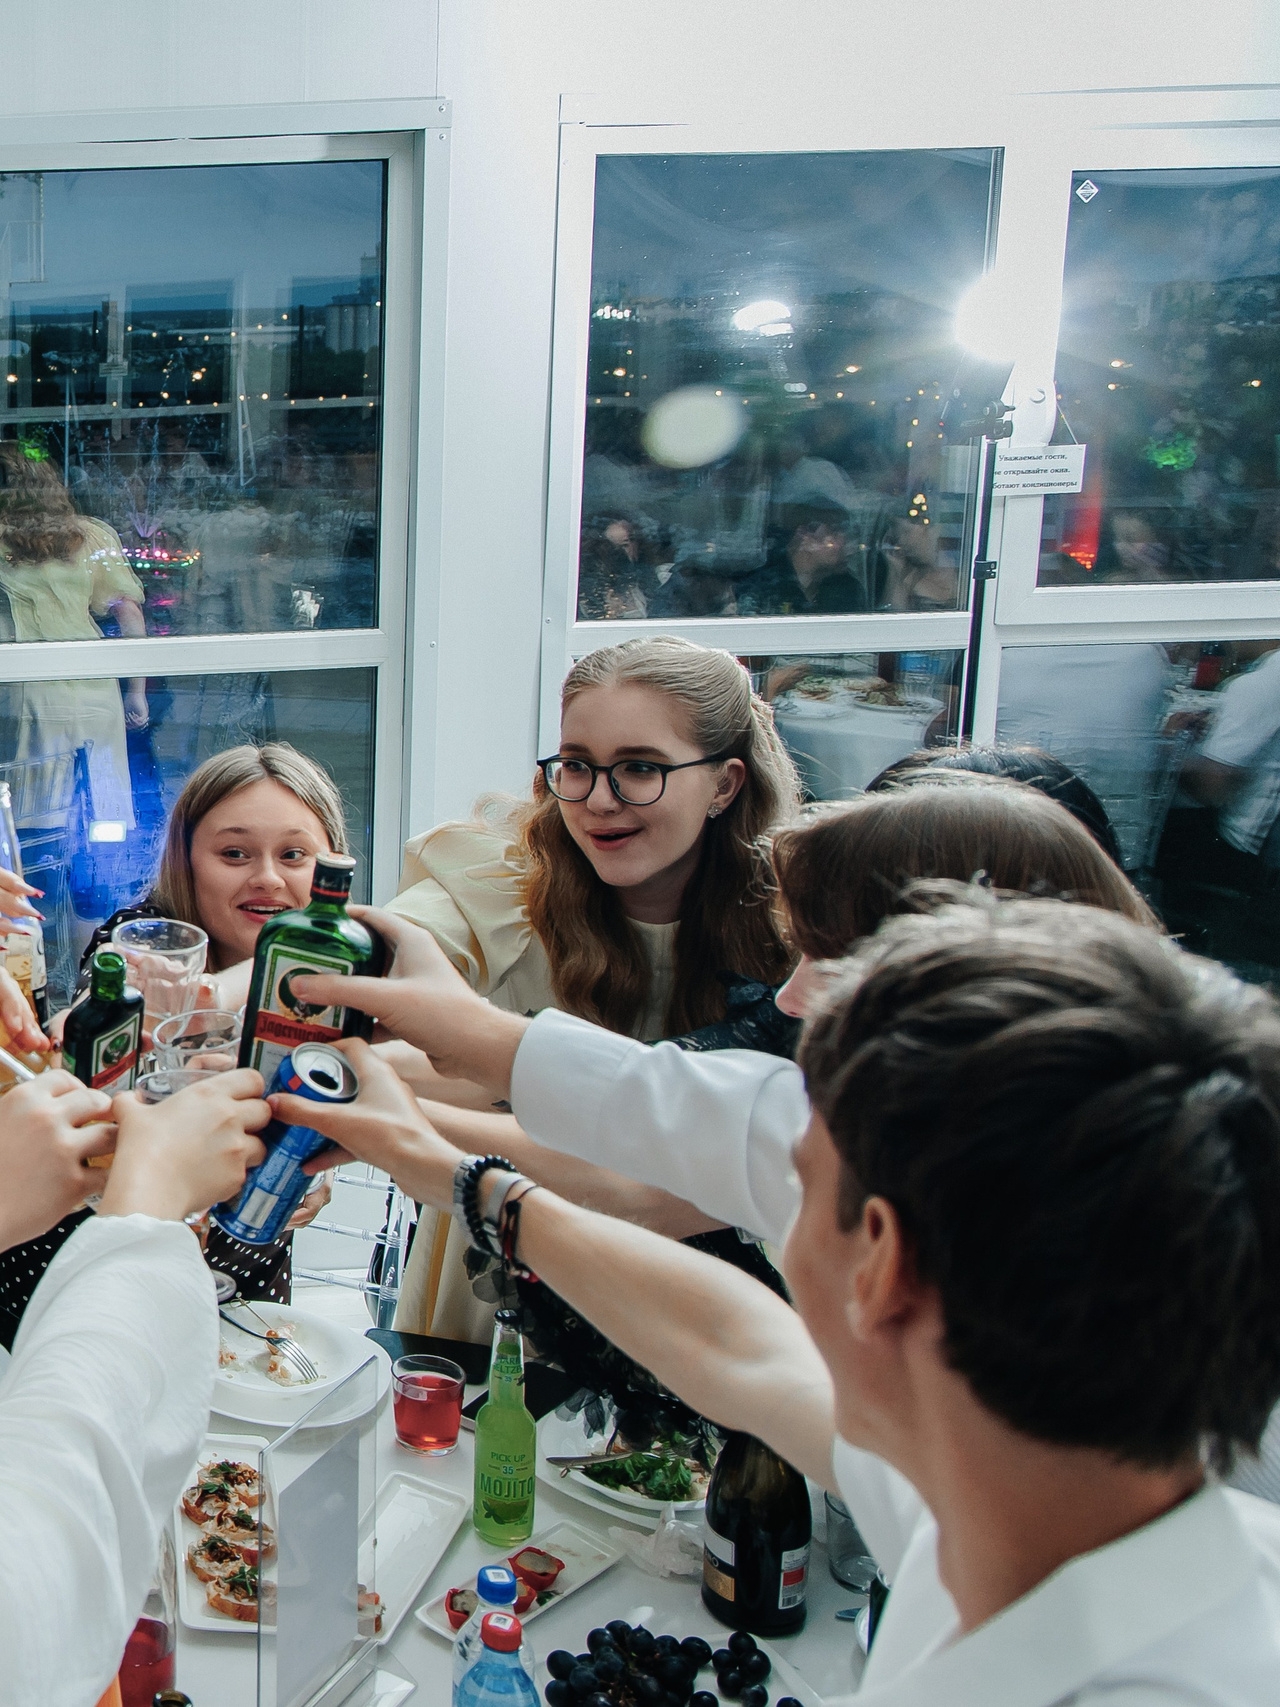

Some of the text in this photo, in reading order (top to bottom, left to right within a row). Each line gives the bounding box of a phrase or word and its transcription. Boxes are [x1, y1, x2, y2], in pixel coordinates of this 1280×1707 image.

[1022, 481, 1078, 490] кондиционеры
[491, 1451, 526, 1463] PICK UP
[502, 1465, 514, 1475] 35
[481, 1473, 533, 1498] MOJITO
